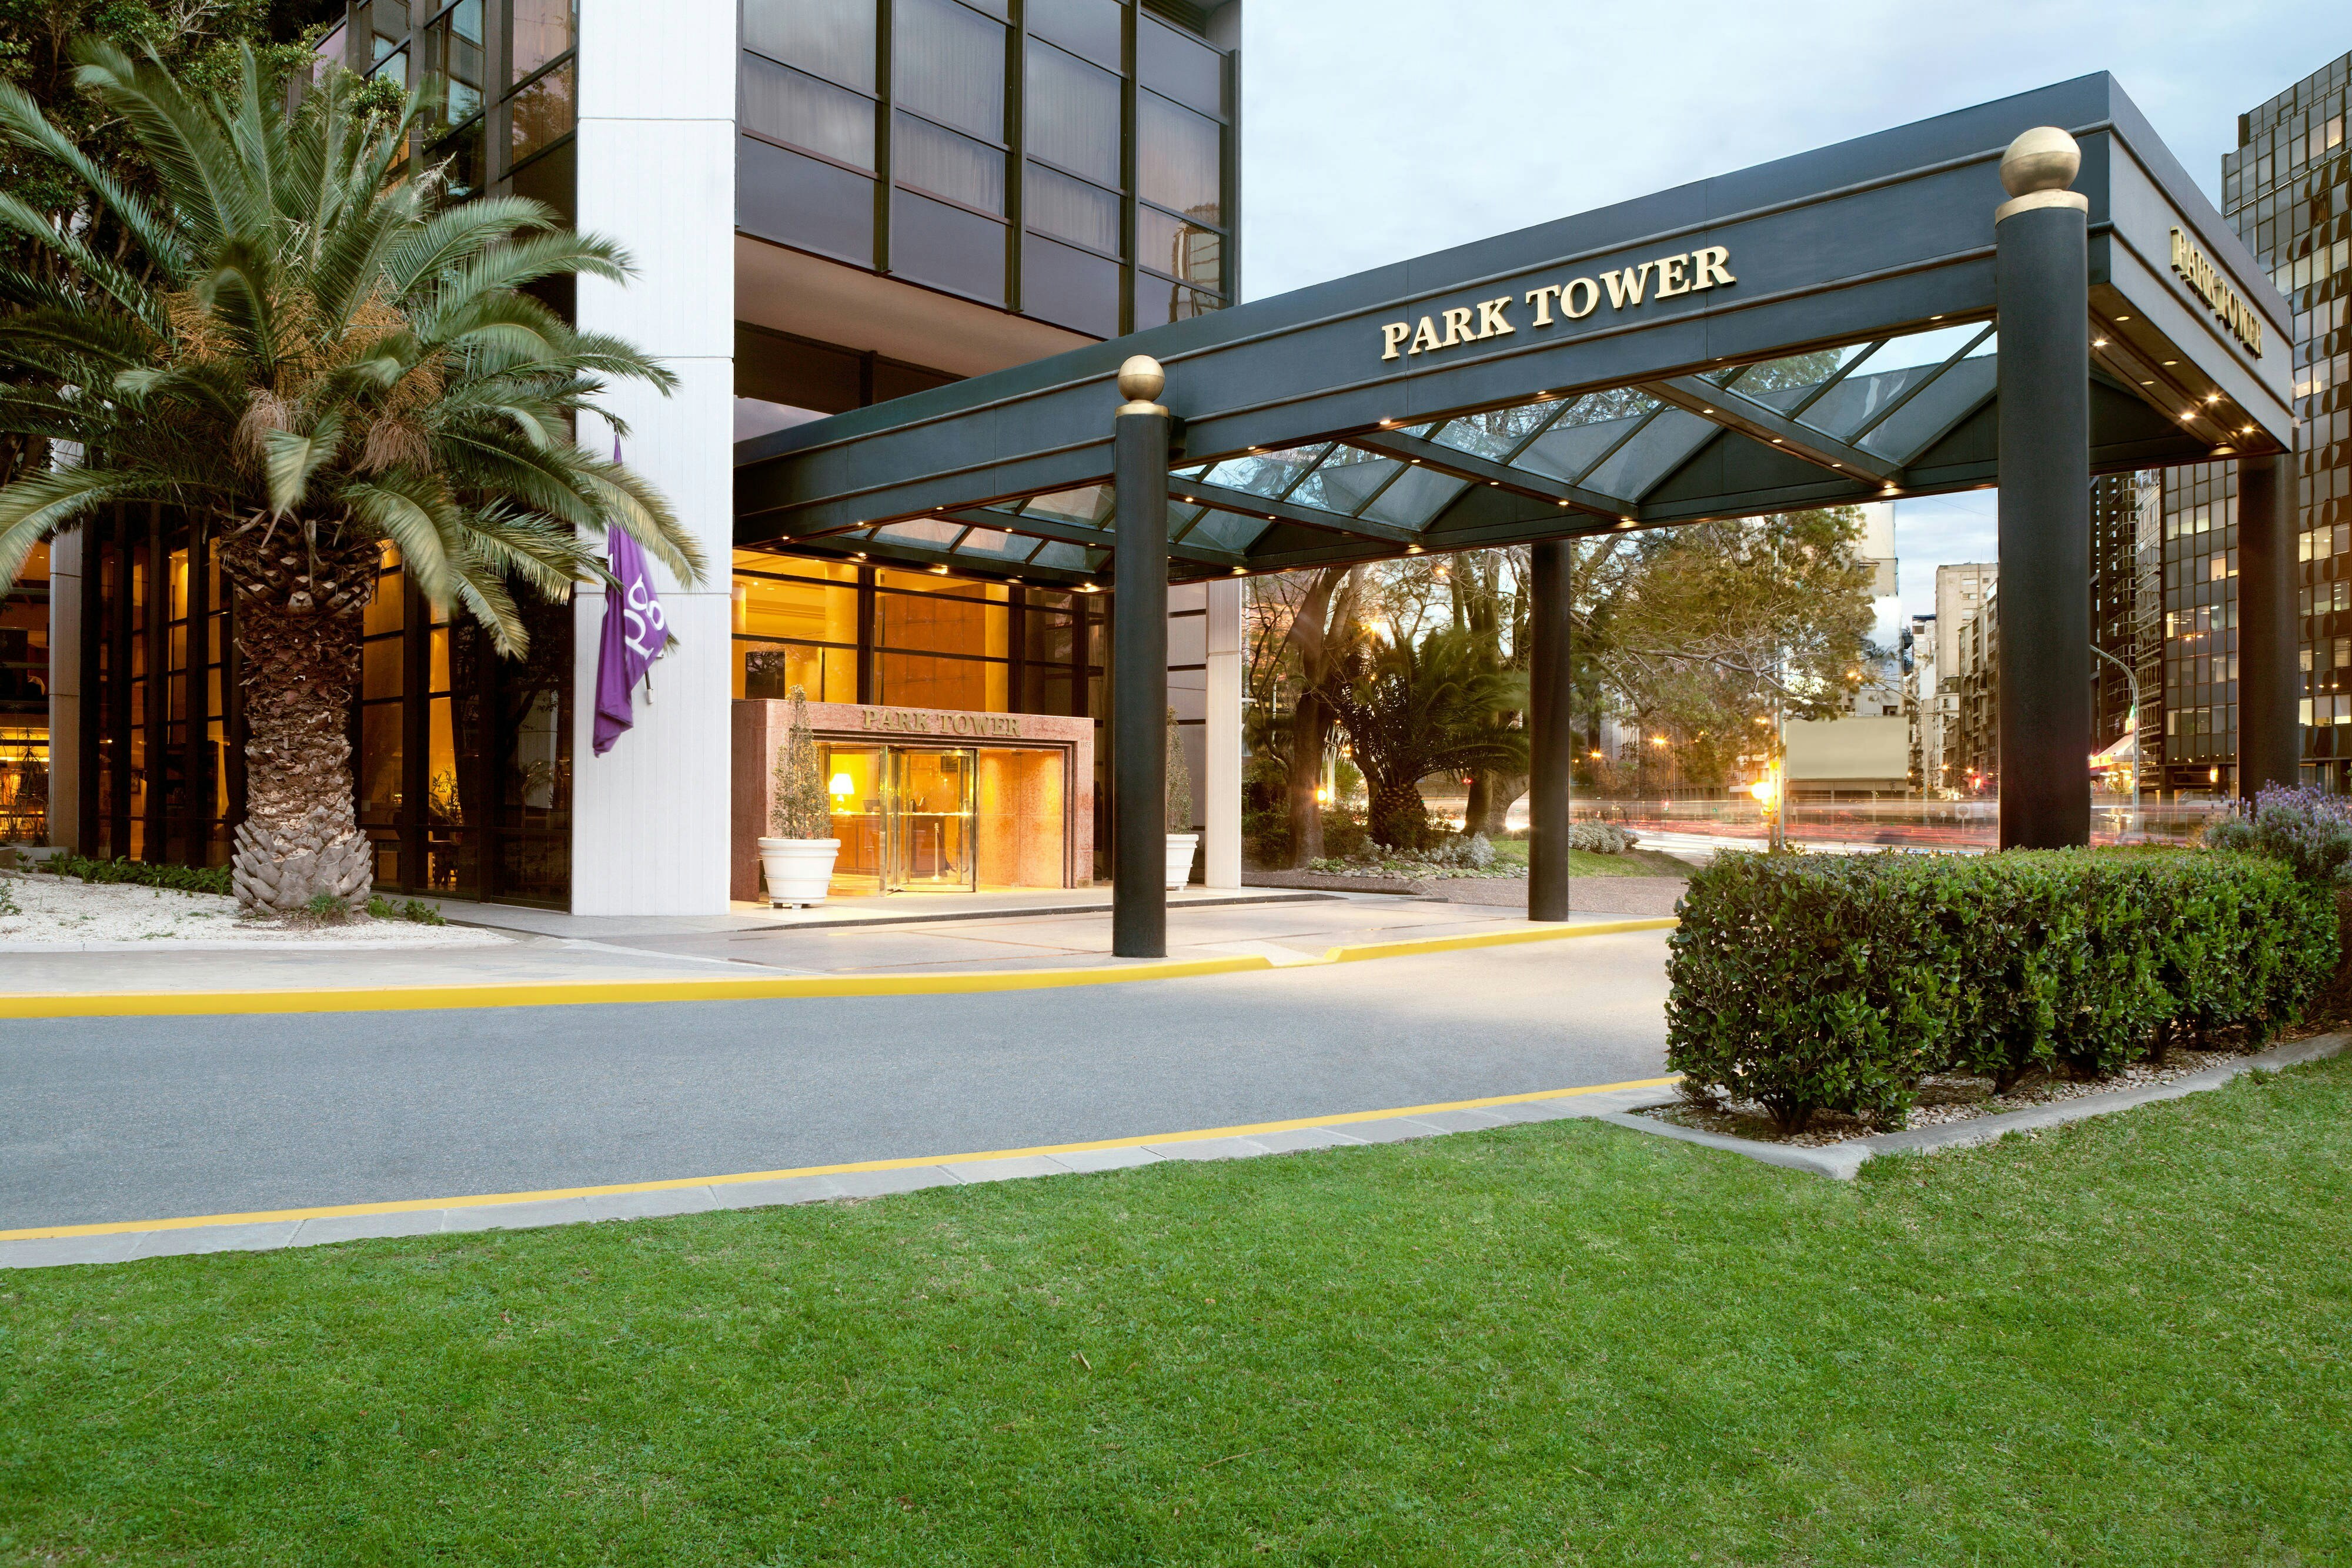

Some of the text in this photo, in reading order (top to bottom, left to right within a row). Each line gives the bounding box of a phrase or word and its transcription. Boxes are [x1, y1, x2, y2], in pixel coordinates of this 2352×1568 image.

[1381, 245, 1737, 361] PARK TOWER
[2170, 226, 2263, 359] PARK TOWER
[863, 708, 1021, 737] PARK TOWER
